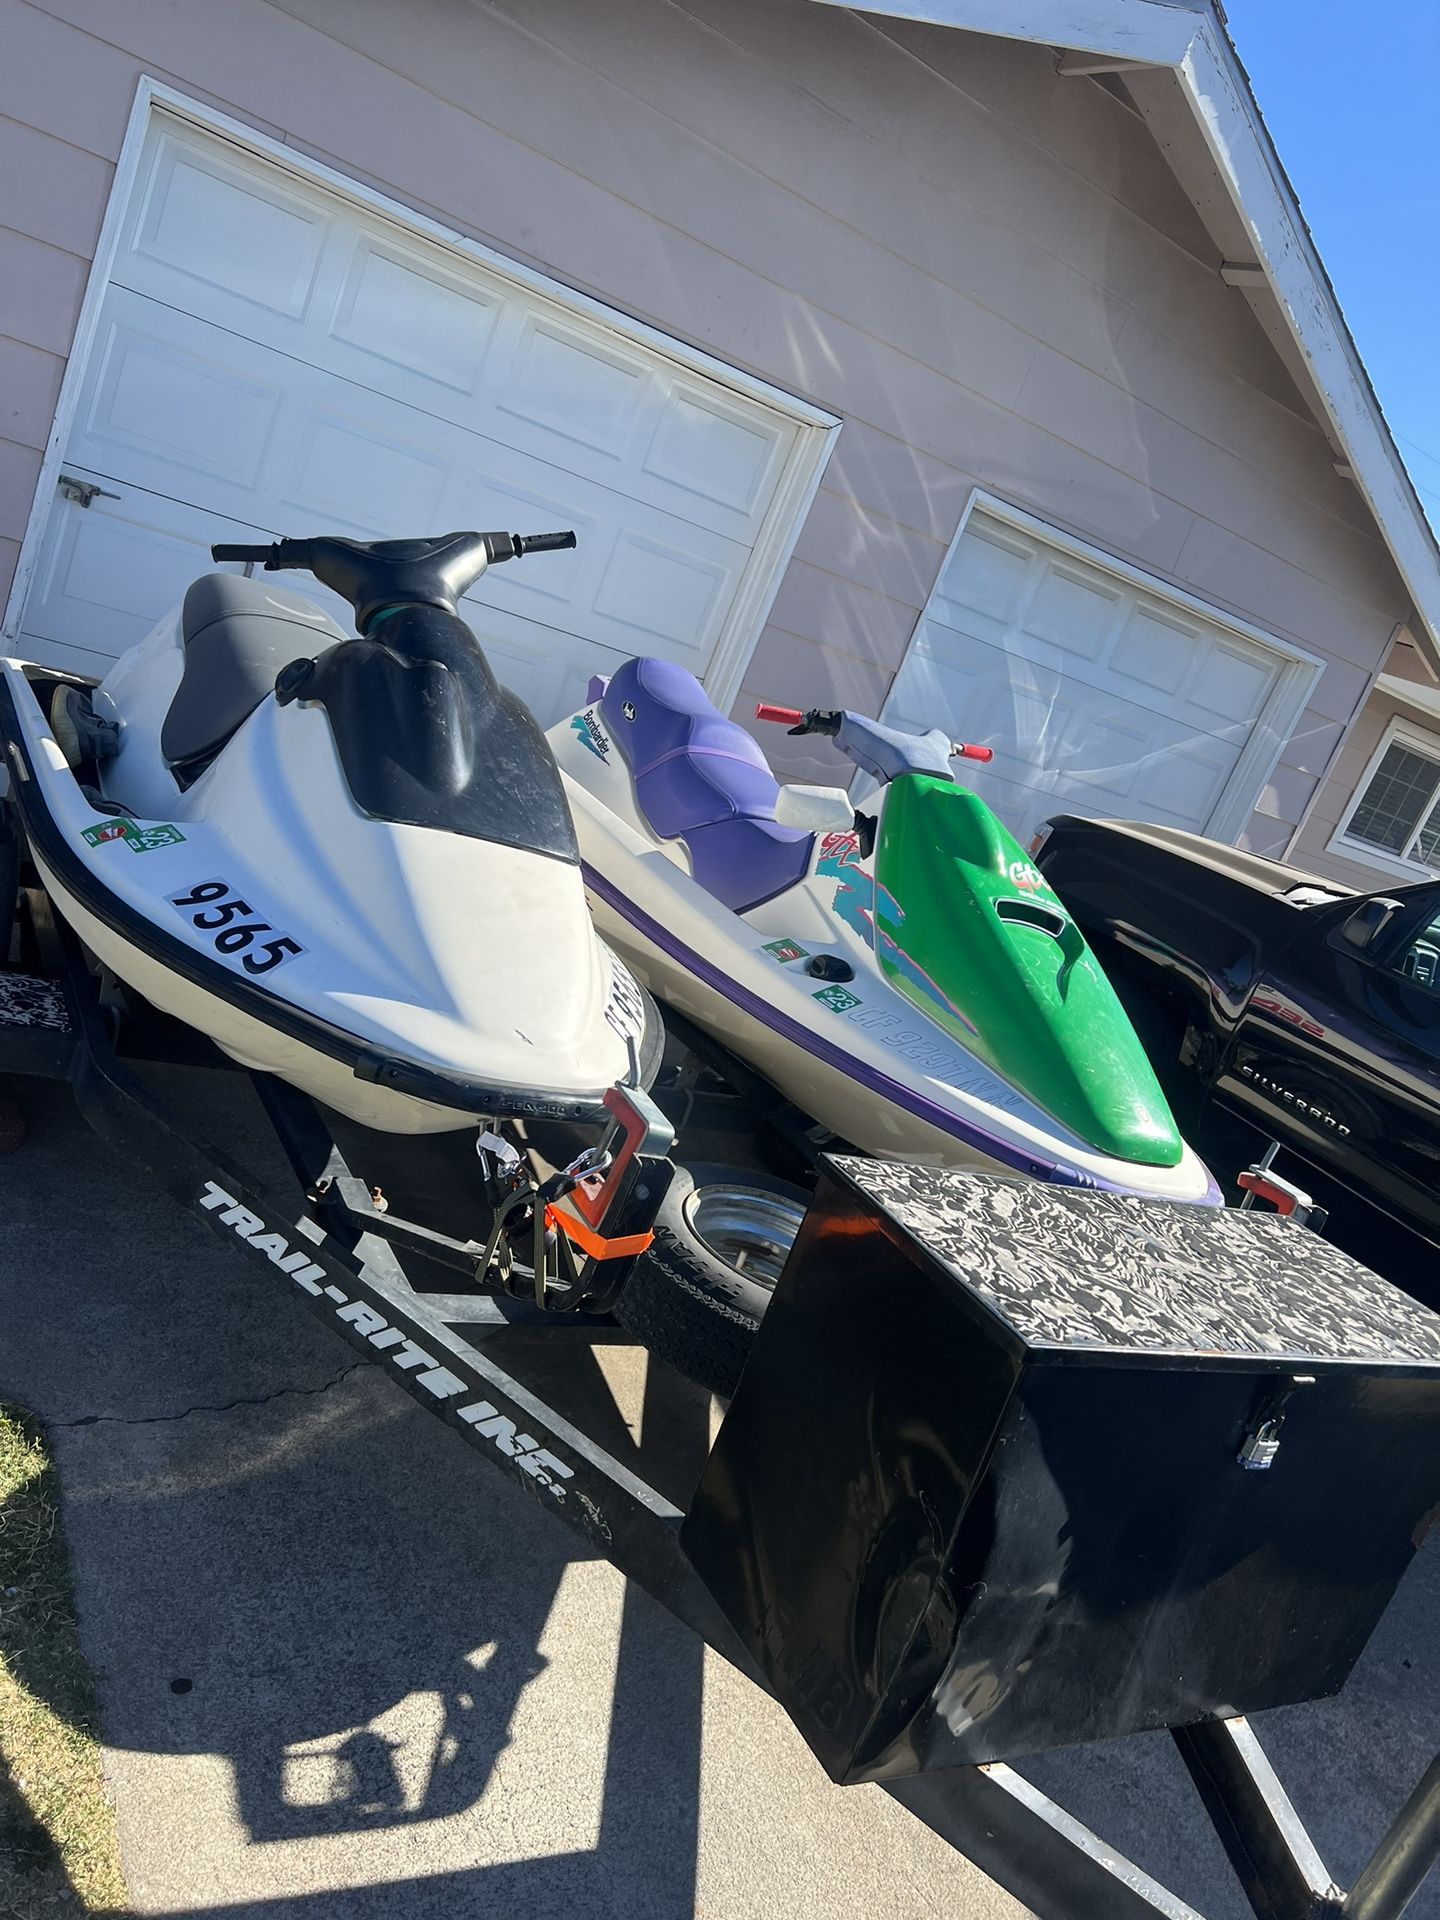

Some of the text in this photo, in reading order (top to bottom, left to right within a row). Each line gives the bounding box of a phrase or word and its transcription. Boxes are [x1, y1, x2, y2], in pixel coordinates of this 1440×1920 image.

[583, 709, 610, 755] Bombardier
[140, 831, 175, 849] 23
[171, 882, 303, 975] 9565
[825, 992, 856, 1010] 23
[847, 1006, 902, 1029] CF
[199, 1180, 470, 1400] TRAIL-RITE
